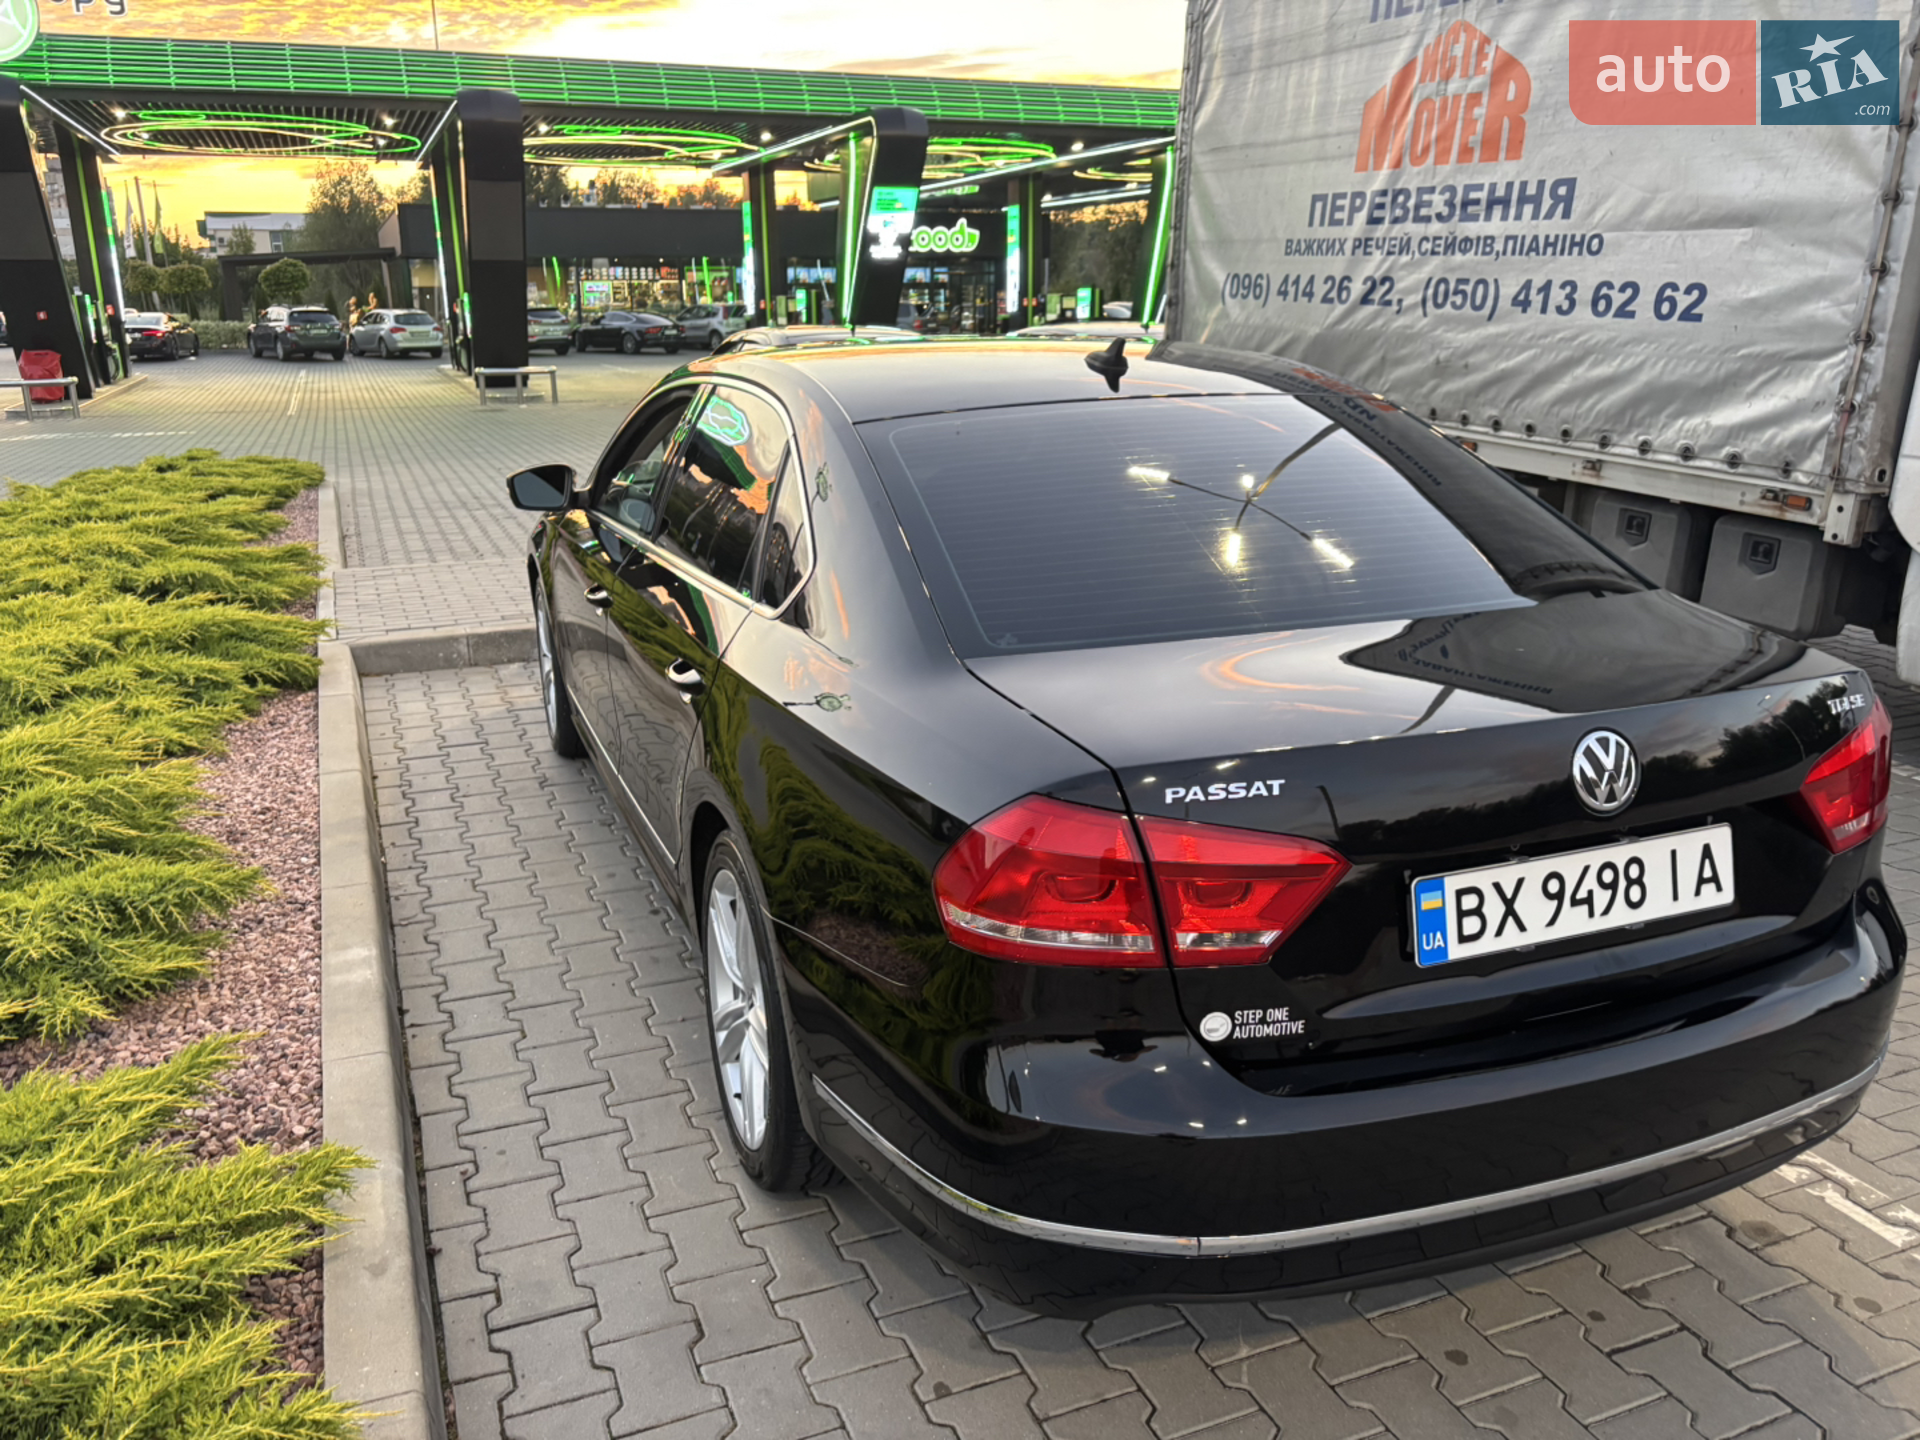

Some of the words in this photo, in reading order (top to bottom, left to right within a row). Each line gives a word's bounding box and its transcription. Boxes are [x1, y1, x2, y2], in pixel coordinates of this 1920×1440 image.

[1308, 177, 1577, 227] ПЕРЕВЕЗЕННЯ
[1284, 238, 1348, 256] ВАЖКИХ
[1221, 272, 1270, 308] (096)
[1277, 273, 1315, 303] 414
[1320, 275, 1352, 305] 26
[1421, 276, 1500, 321] (050)
[1511, 278, 1578, 316] 413
[1590, 280, 1640, 319] 62
[1653, 281, 1708, 323] 62
[1165, 779, 1285, 804] PASSAT
[1455, 876, 1528, 945] BX
[1541, 855, 1647, 929] 9498
[1669, 842, 1724, 902] IA
[1422, 930, 1445, 950] UA
[1234, 1009, 1263, 1024] STEP
[1266, 1007, 1289, 1022] ONE
[1233, 1019, 1305, 1039] AUTOMOTIVE
